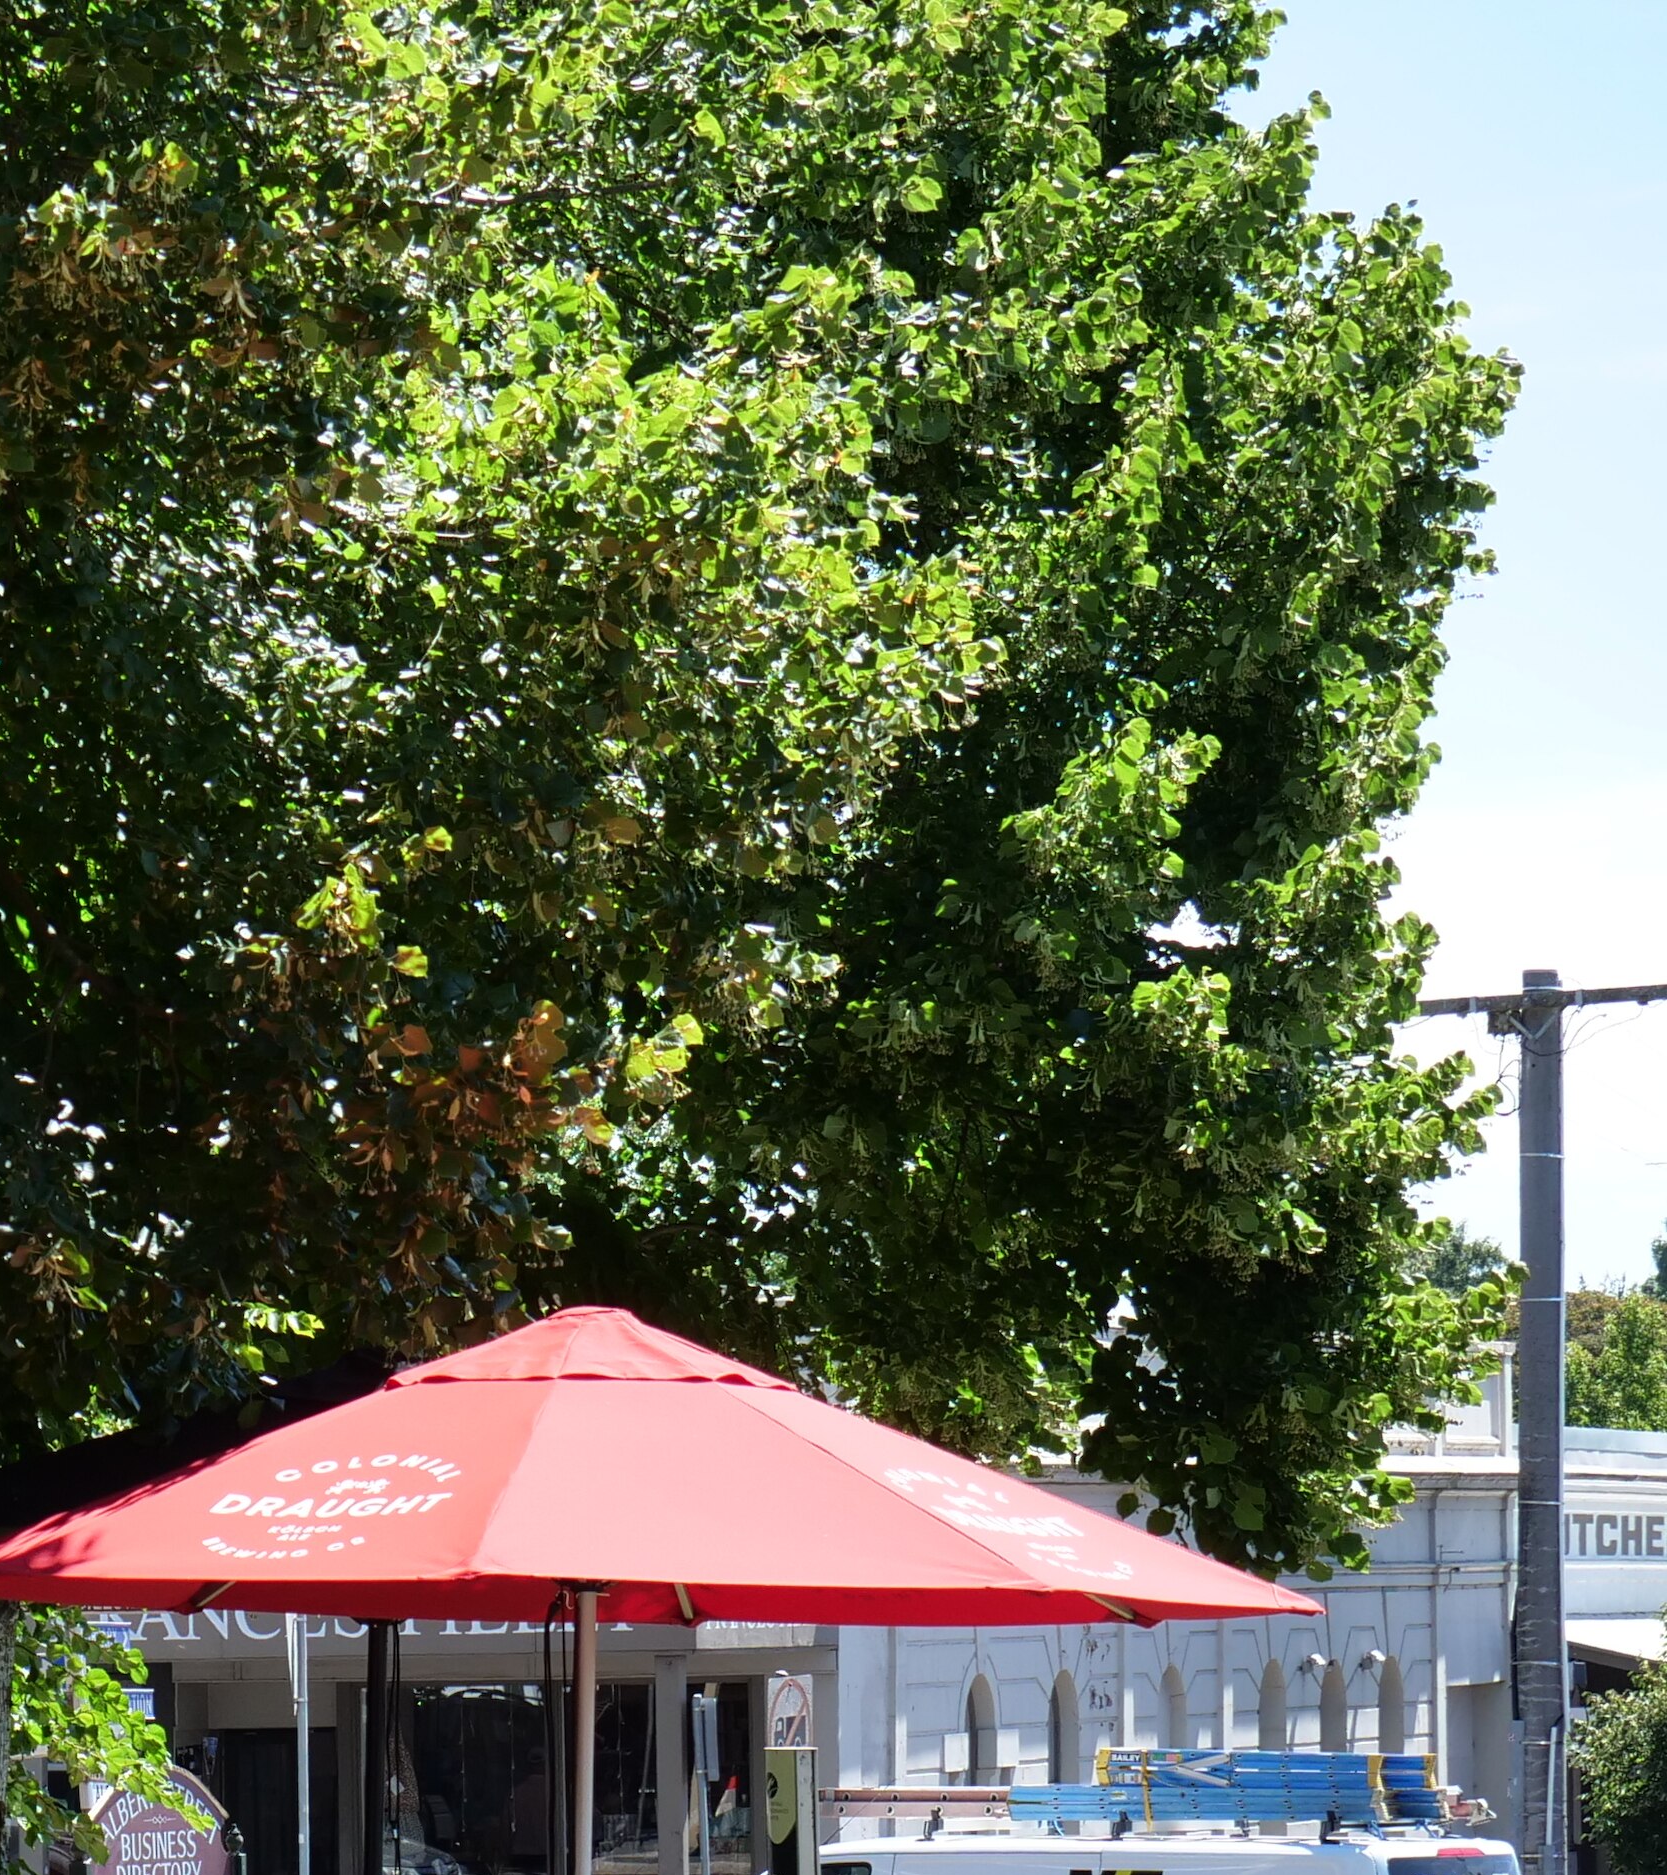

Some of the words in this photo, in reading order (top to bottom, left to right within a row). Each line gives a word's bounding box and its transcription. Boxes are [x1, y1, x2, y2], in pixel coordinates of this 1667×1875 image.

[274, 1453, 462, 1483] COLONIAL
[209, 1492, 454, 1519] DRAUGHT
[1111, 1753, 1141, 1762] BAILEY
[100, 1789, 155, 1842] ALBER
[121, 1830, 197, 1862] BUSINESS
